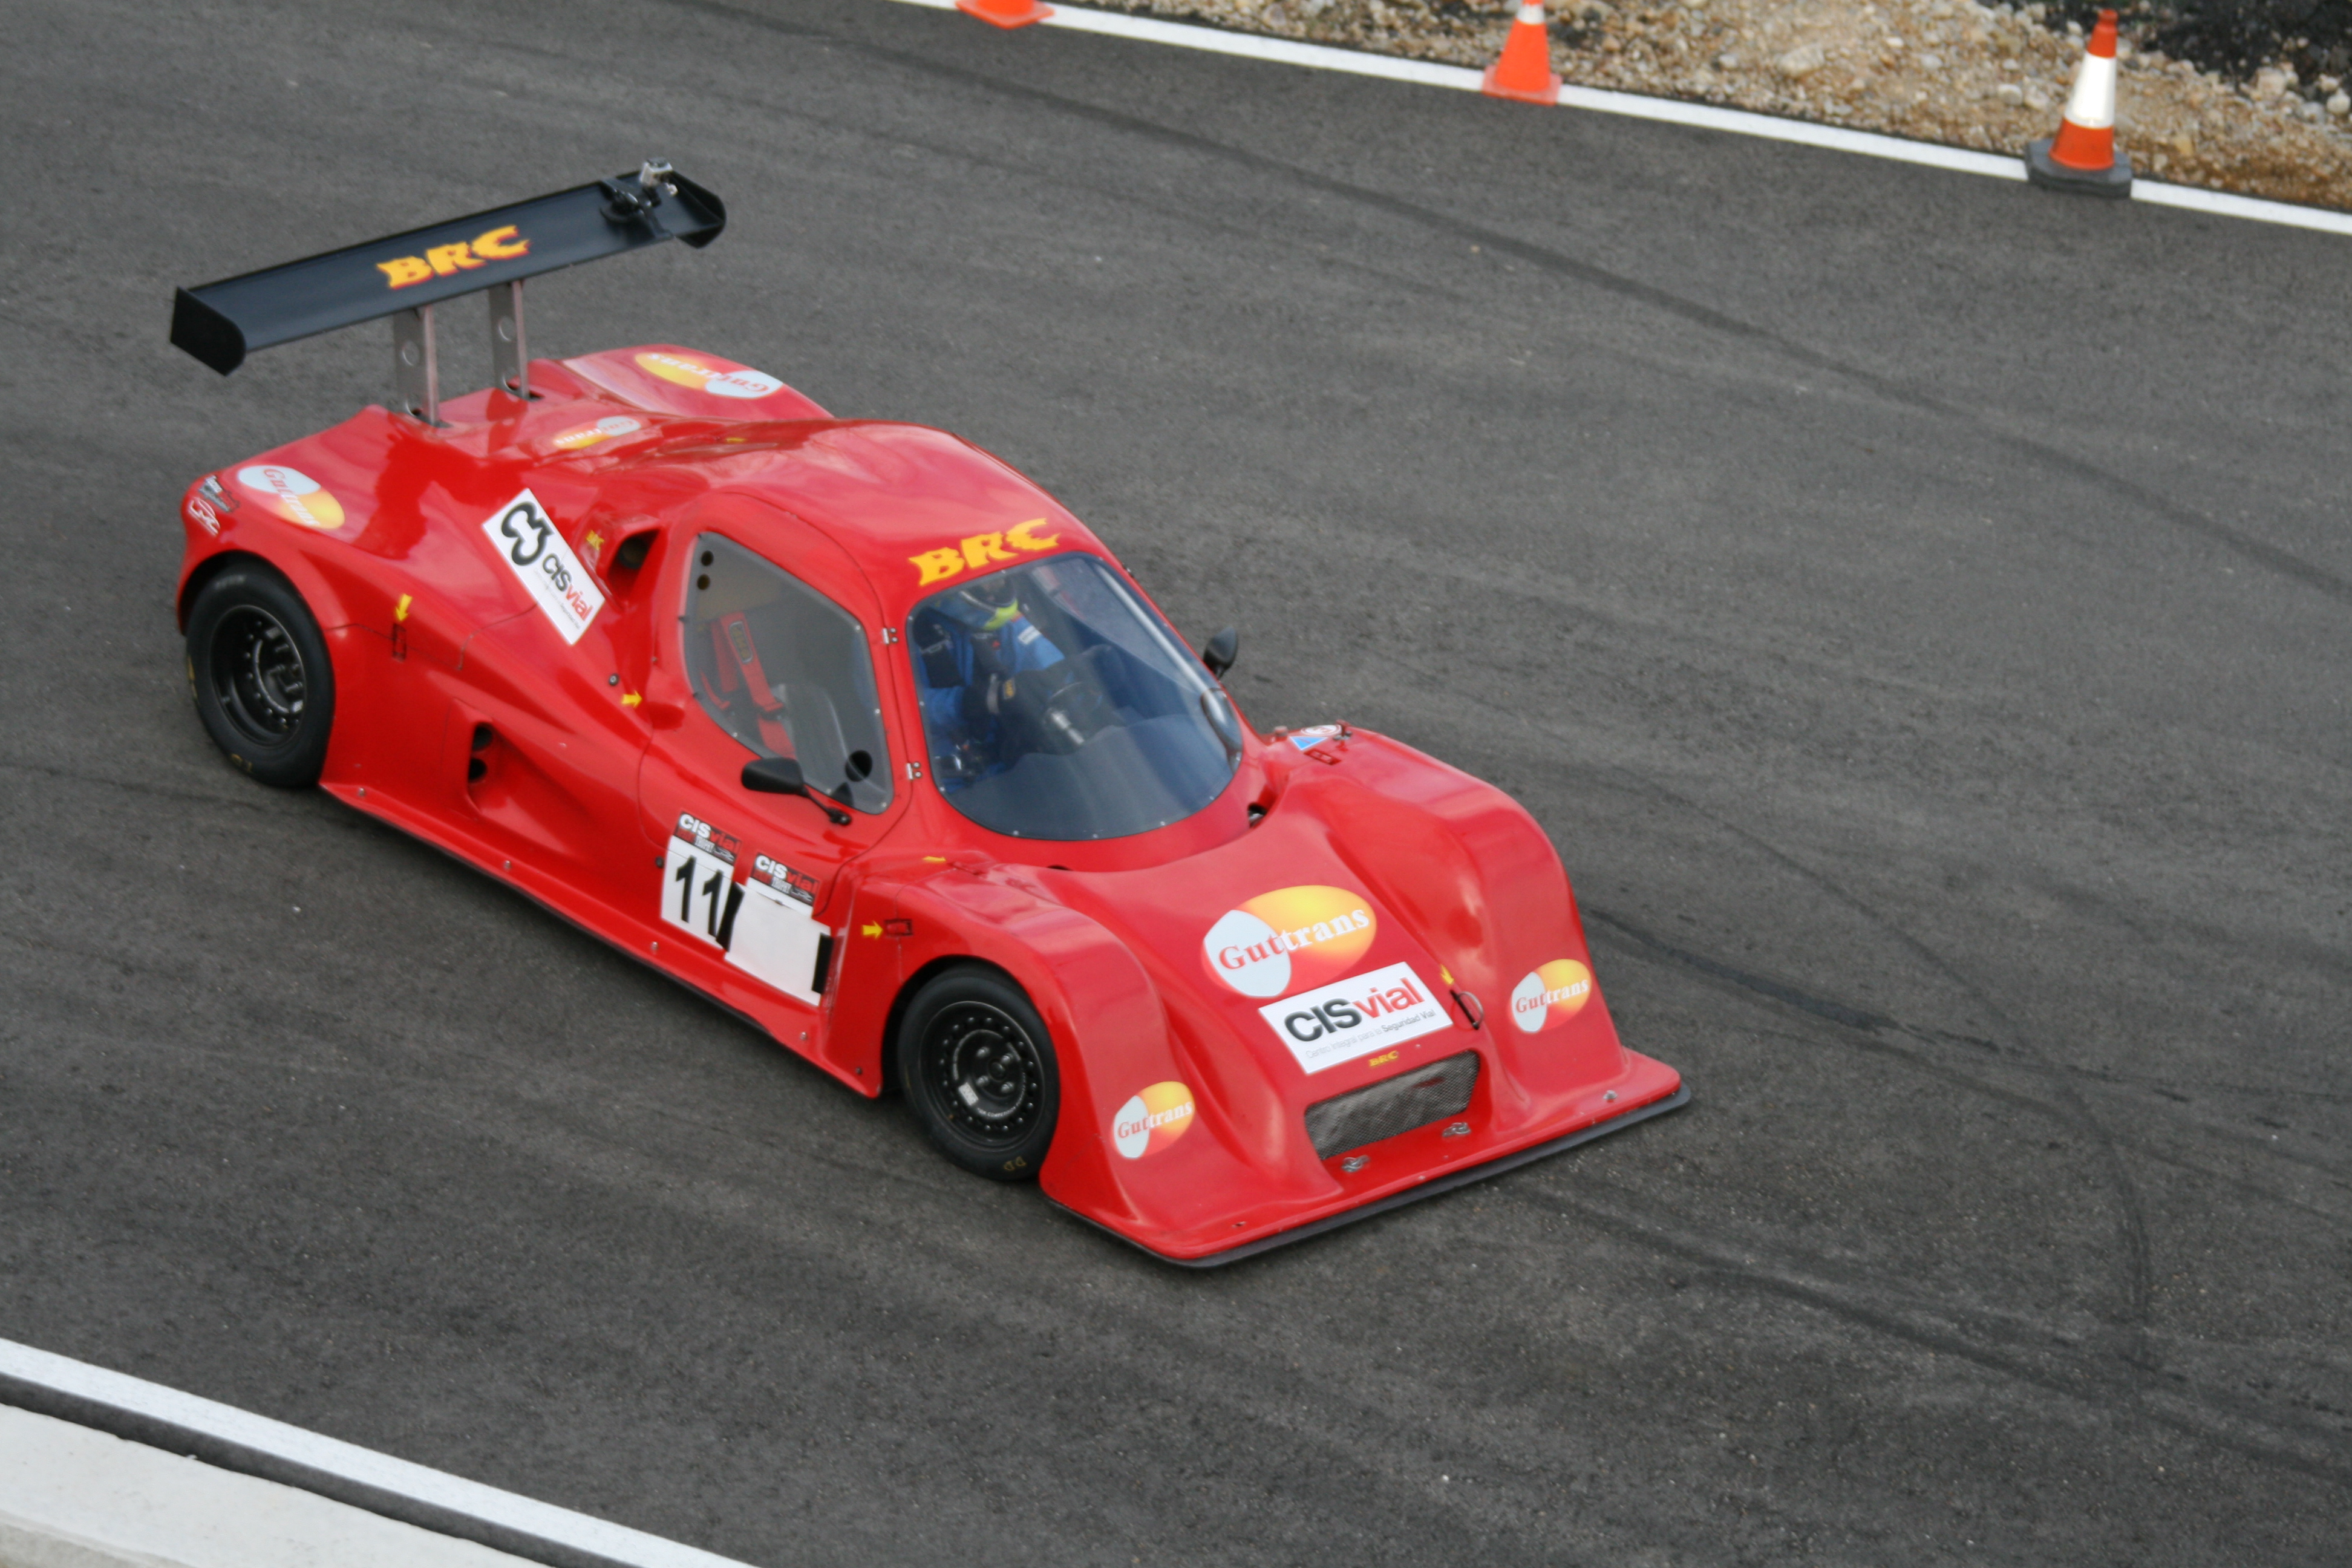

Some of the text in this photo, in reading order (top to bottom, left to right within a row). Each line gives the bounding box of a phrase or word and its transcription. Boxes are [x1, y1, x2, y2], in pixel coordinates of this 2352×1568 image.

[376, 224, 532, 290] BRC
[909, 518, 1060, 586] BRC
[675, 854, 724, 939] 11
[1218, 908, 1370, 970] Guttrans
[1284, 976, 1426, 1042] CISvial
[1381, 1014, 1420, 1033] Seguridad
[1419, 1008, 1437, 1019] Vial
[1515, 979, 1589, 1013] Guttrans
[1369, 1050, 1399, 1067] BRC
[1118, 1101, 1193, 1138] Guttrans
